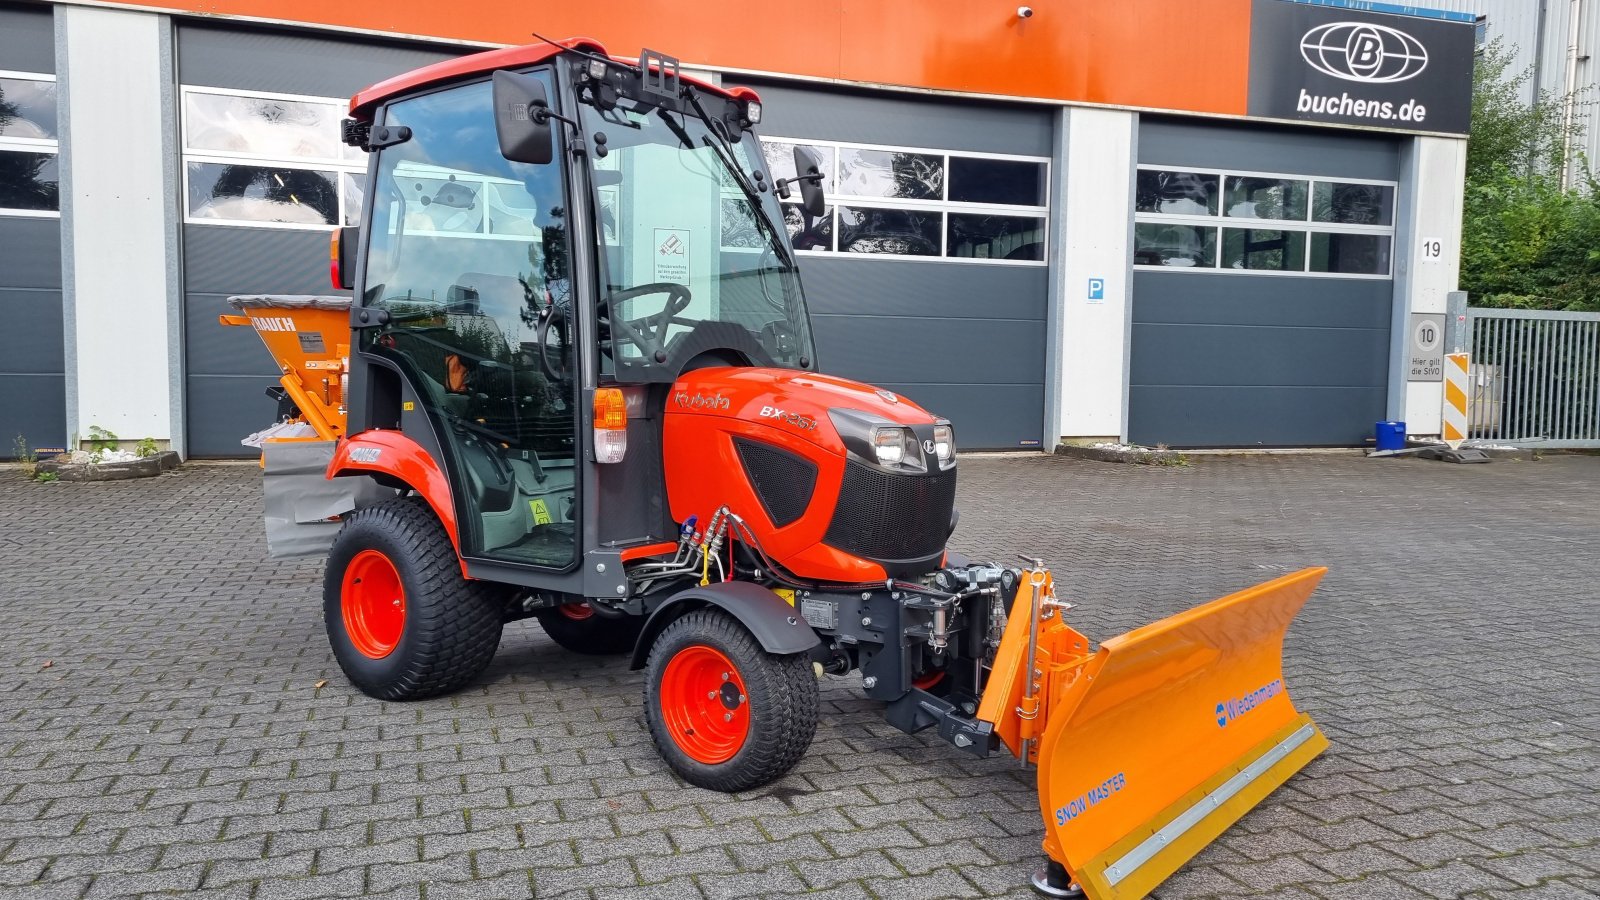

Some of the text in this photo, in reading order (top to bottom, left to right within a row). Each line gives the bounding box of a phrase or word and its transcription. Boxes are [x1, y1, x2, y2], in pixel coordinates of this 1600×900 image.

[1297, 89, 1426, 122] buchens.de
[1424, 241, 1441, 257] 19
[1090, 280, 1102, 298] P
[252, 317, 296, 332] RAUCH
[1421, 328, 1434, 343] 10
[1412, 357, 1440, 367] Hier gilt
[1411, 367, 1440, 375] die StVO
[674, 391, 730, 410] Kubota
[1226, 679, 1283, 721] Wiedenmann
[1056, 772, 1127, 827] SNOW MASTER
